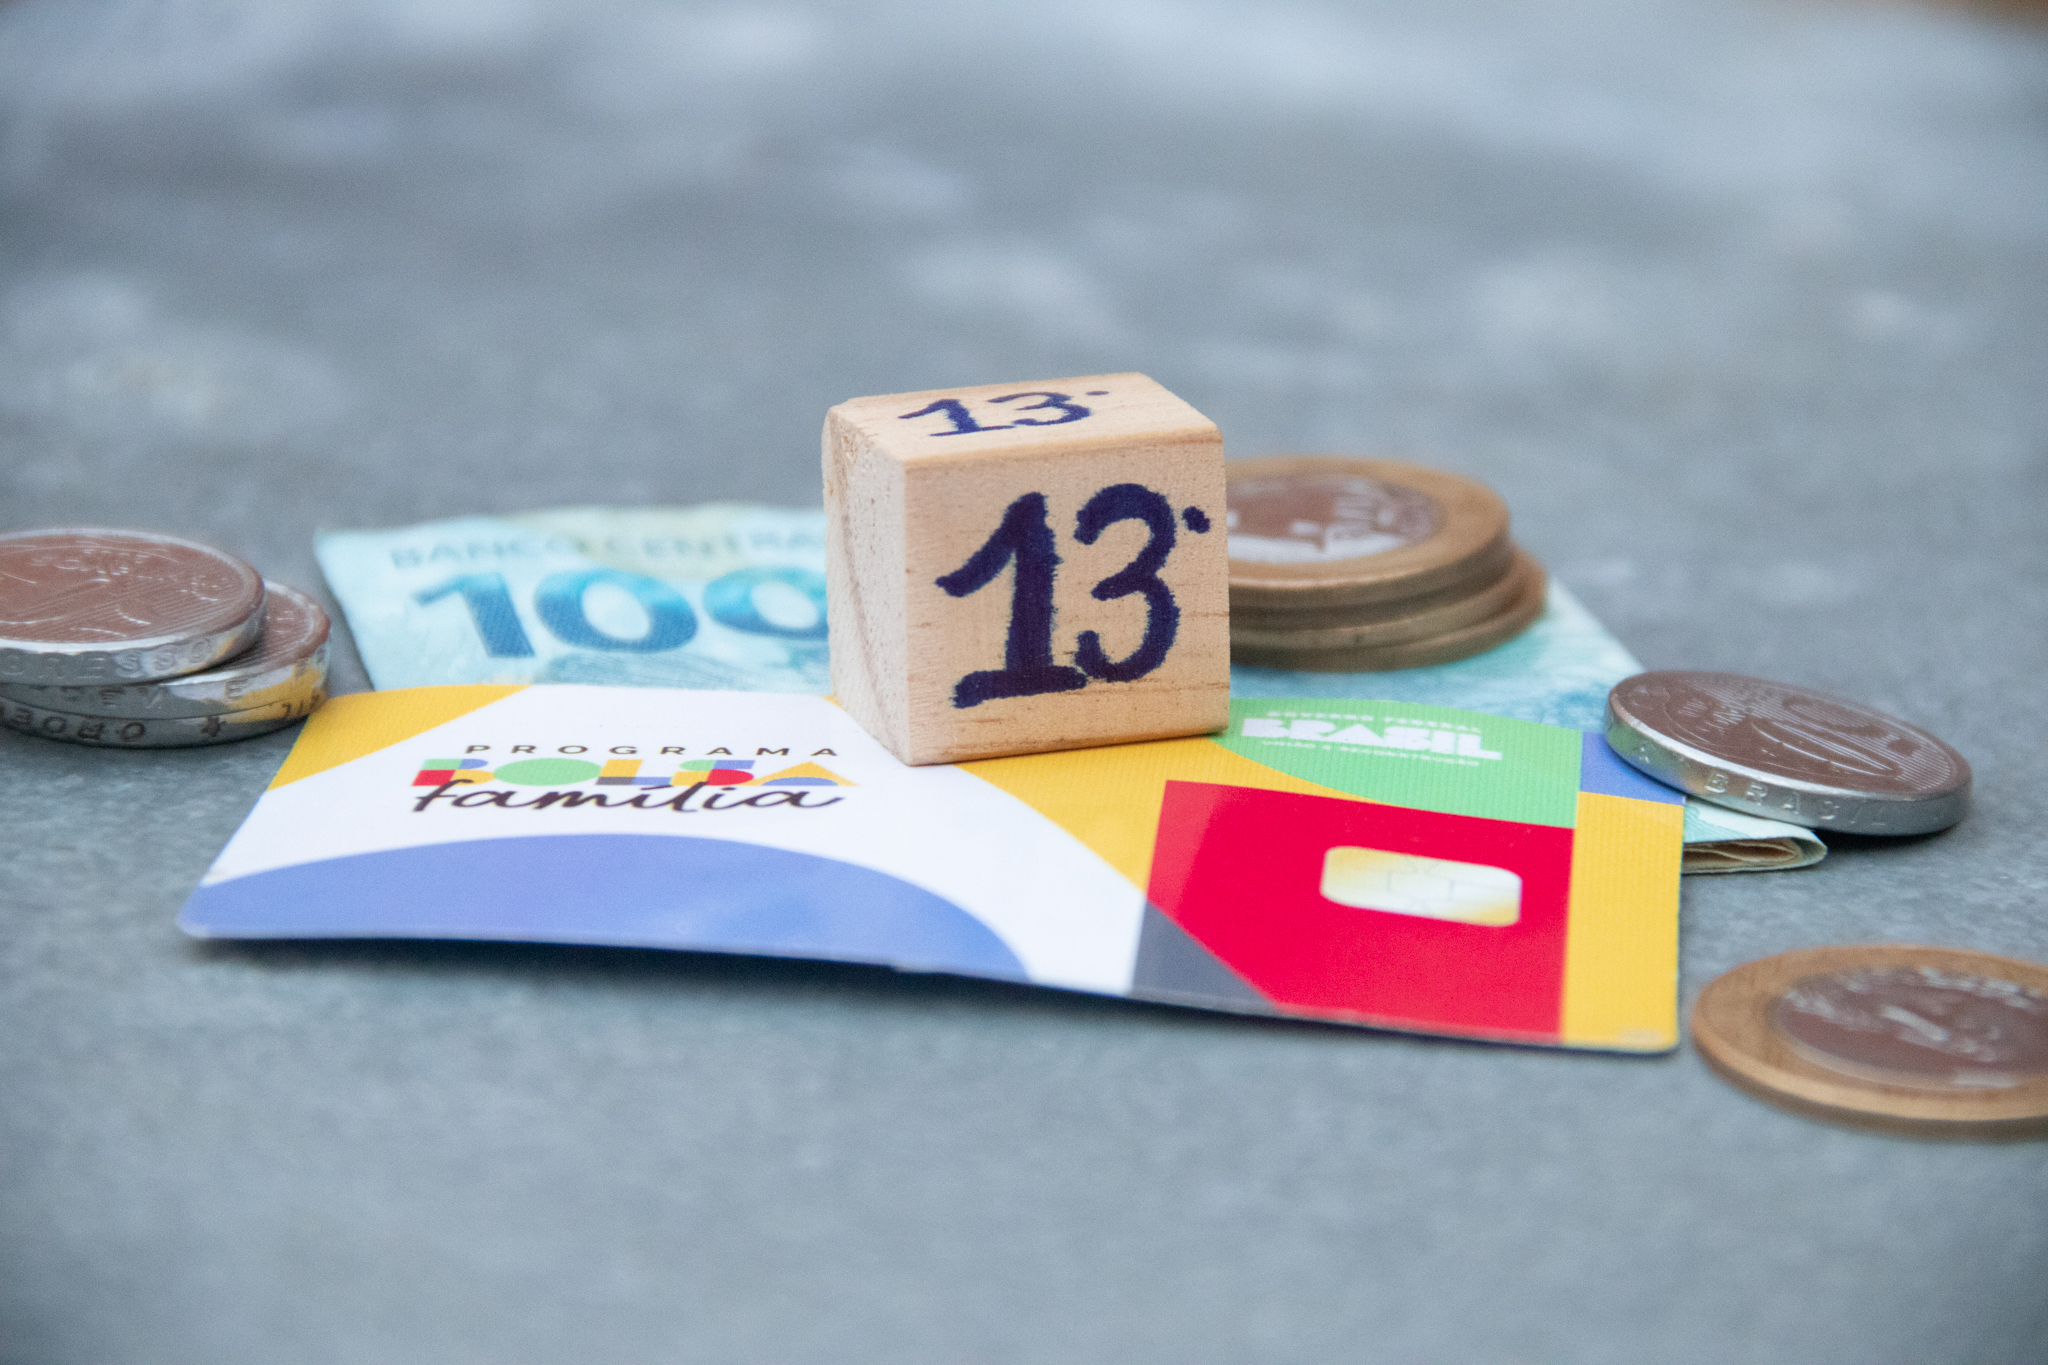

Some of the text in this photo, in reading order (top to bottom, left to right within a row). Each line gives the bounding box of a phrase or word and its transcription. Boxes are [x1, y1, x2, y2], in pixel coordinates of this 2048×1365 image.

[411, 565, 829, 659] 100
[464, 744, 839, 757] PROGRAMA
[1241, 718, 1503, 761] BRASIL
[411, 757, 860, 787] BOLSA
[411, 778, 845, 813] família
